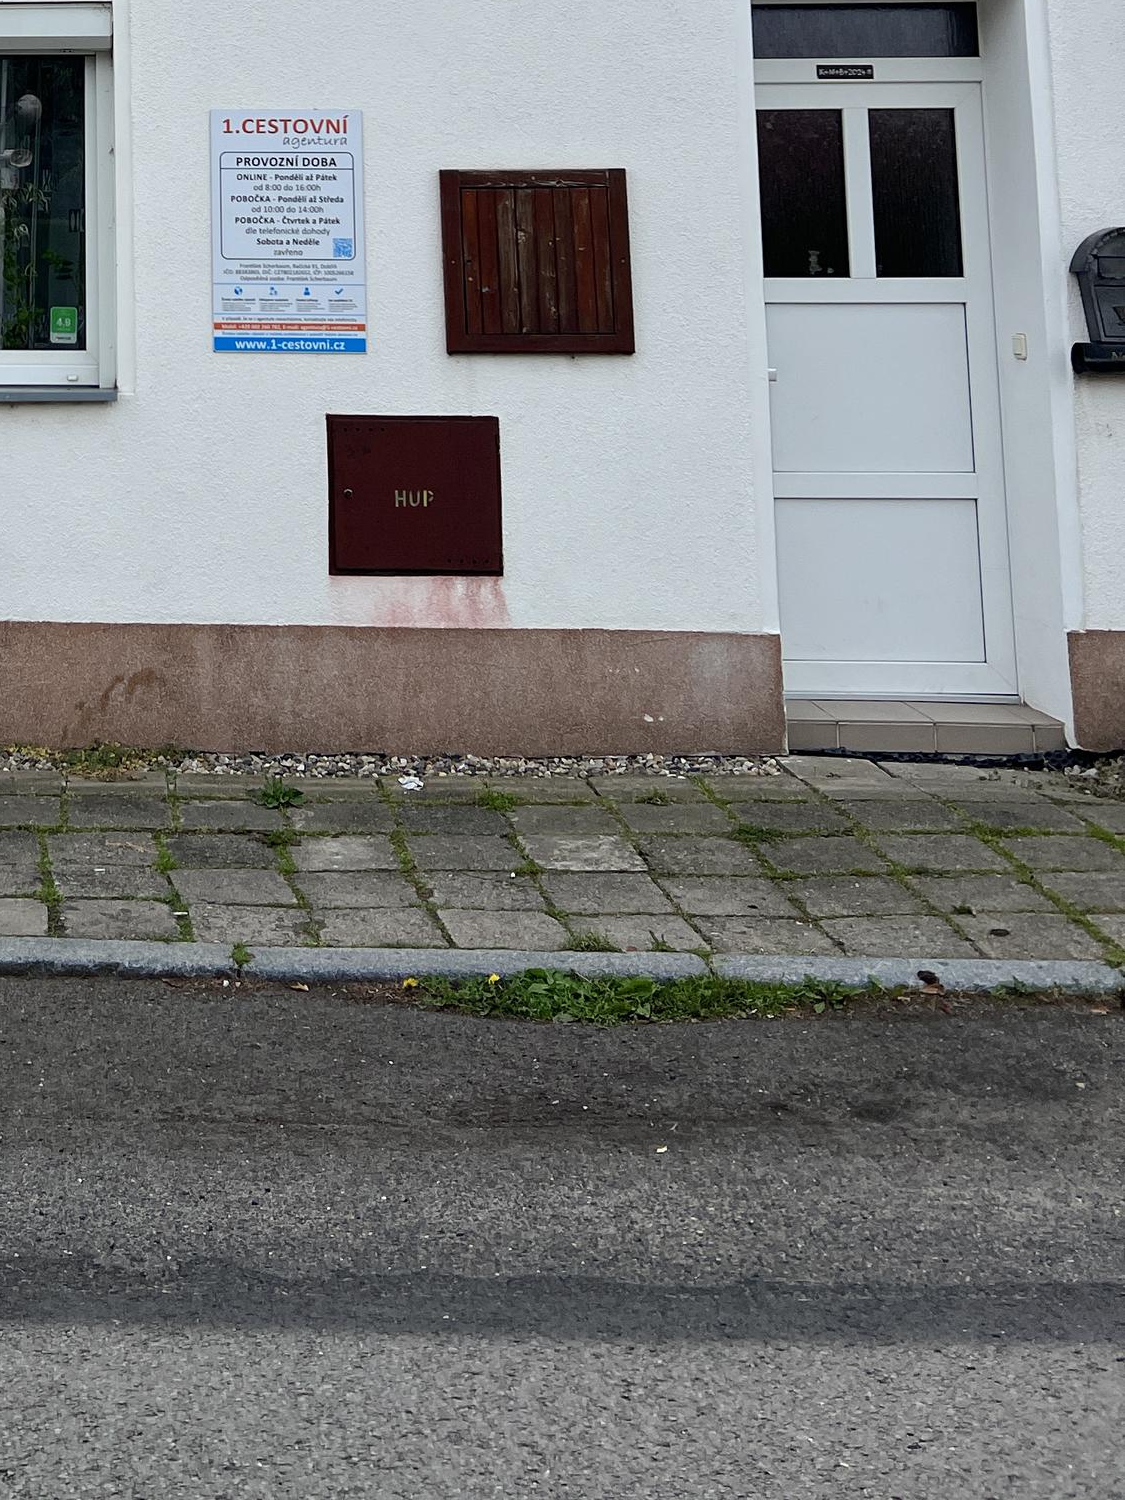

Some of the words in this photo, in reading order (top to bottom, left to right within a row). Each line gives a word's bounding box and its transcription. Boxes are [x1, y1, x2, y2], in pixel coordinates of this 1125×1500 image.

[222, 115, 349, 134] 1.CESTOVNÍ
[283, 136, 348, 148] agentura
[236, 155, 299, 166] PROVOZNÍ
[303, 157, 337, 167] DOBA
[235, 340, 345, 350] www.1-cestovni.cz
[394, 490, 434, 507] HUP
